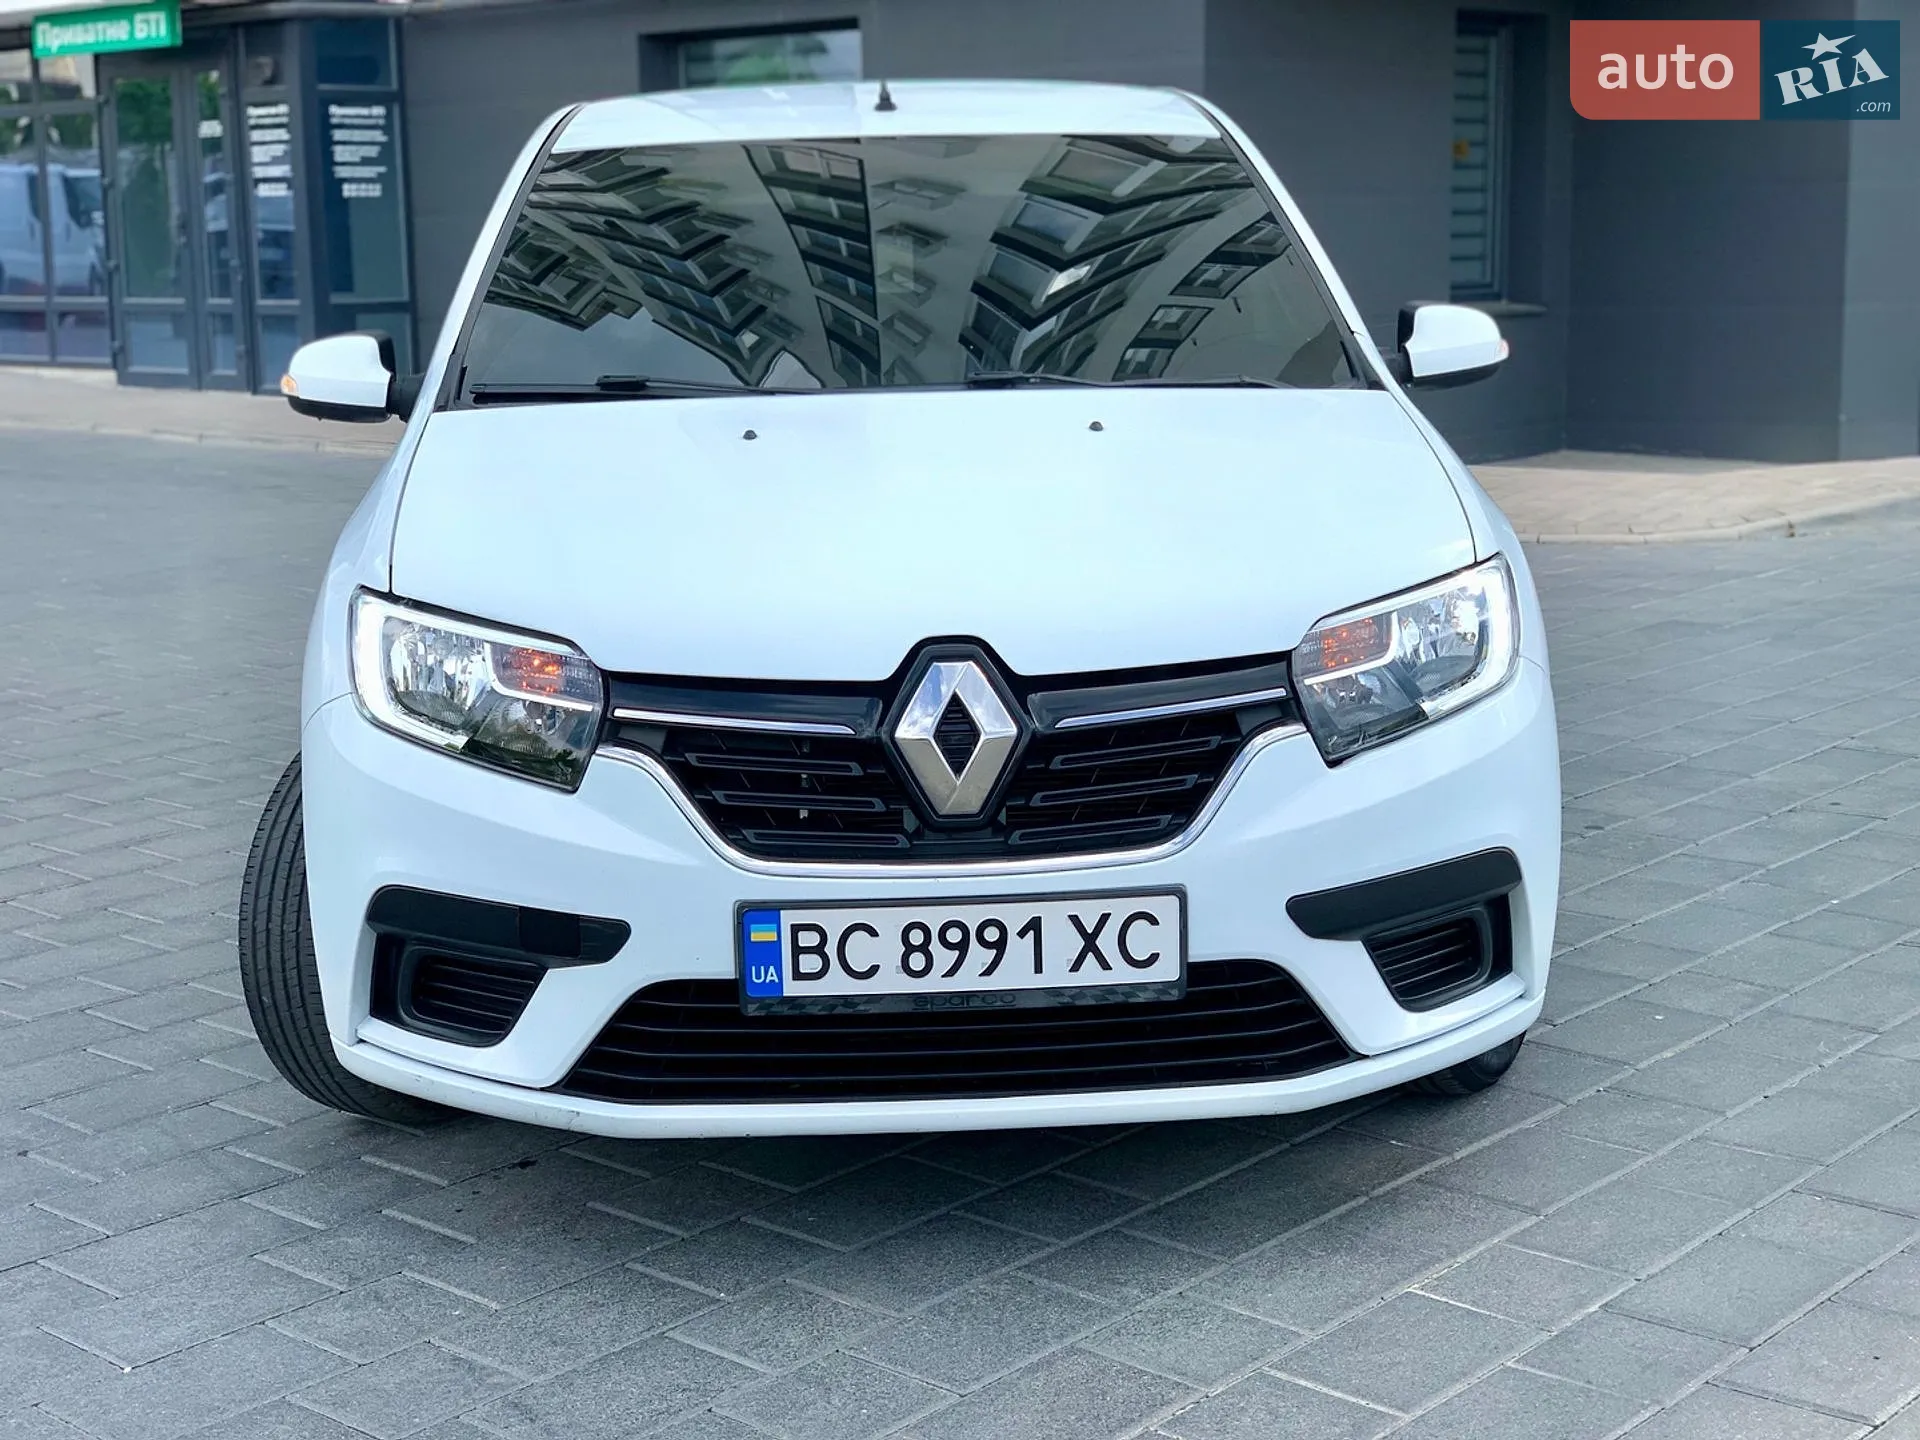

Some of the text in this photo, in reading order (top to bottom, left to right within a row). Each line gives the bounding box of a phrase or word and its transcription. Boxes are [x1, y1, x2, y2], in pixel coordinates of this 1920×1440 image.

[36, 20, 130, 53] Приватне
[789, 910, 1160, 982] BC 8991 XC
[751, 965, 779, 984] UA
